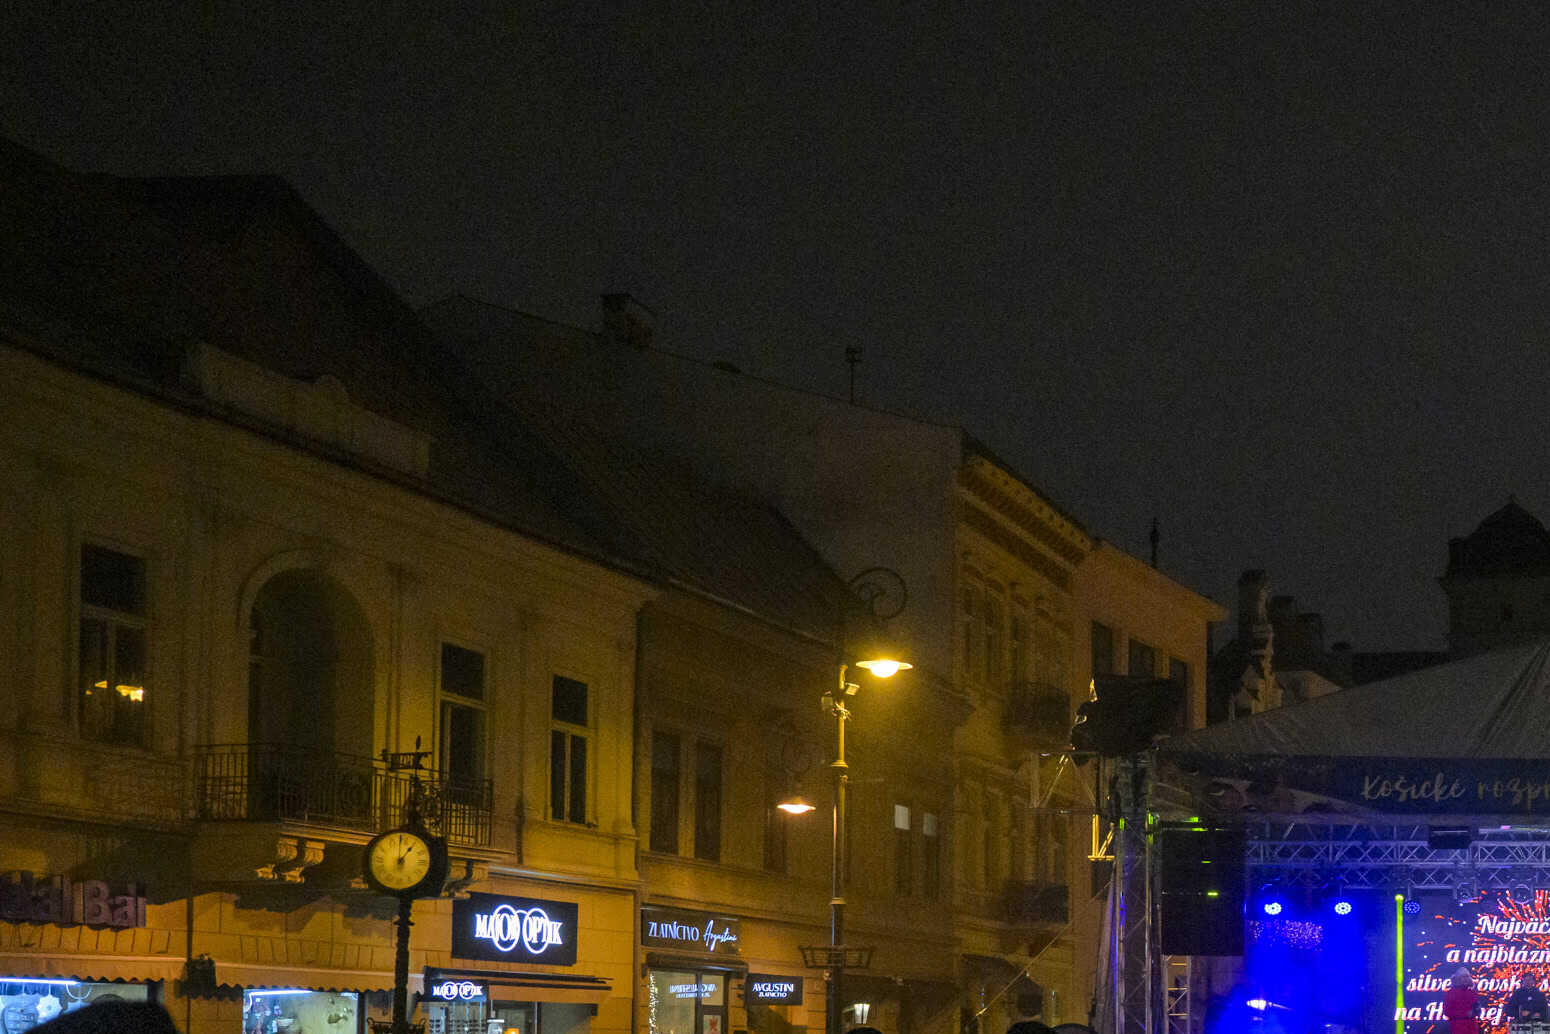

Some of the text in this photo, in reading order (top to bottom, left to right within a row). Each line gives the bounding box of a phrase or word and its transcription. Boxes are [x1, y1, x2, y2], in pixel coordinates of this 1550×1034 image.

[526, 912, 563, 945] OPTIK
[648, 919, 700, 942] ZLATNÍCTVO
[1446, 949, 1460, 963] a
[1394, 1004, 1421, 1021] na
